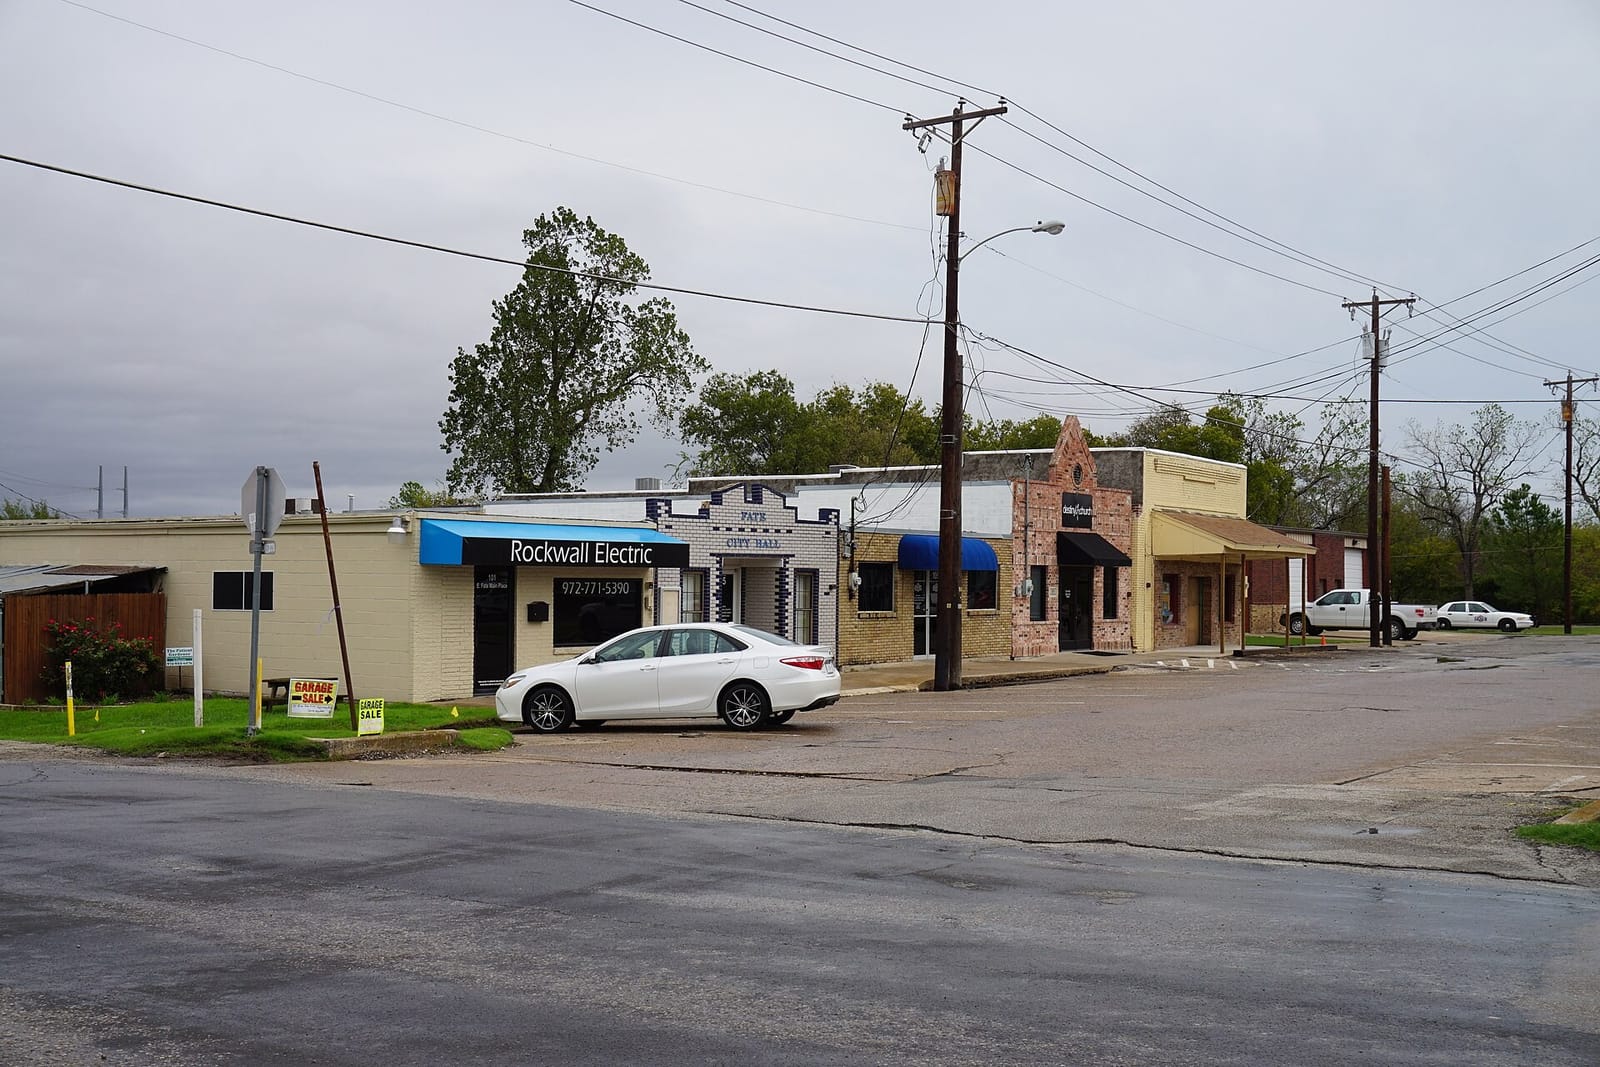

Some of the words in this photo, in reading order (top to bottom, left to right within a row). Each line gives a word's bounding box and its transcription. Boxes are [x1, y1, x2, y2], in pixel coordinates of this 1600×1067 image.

[741, 511, 767, 521] FATE
[727, 537, 750, 548] CITY
[755, 538, 781, 549] HALL
[511, 540, 589, 564] Rockwall
[595, 543, 653, 564] Electric
[562, 581, 630, 595] 972-771-5390
[294, 682, 334, 694] GARAGE
[302, 693, 324, 704] SALE
[360, 700, 383, 710] GARAGE
[360, 710, 382, 720] SALE
